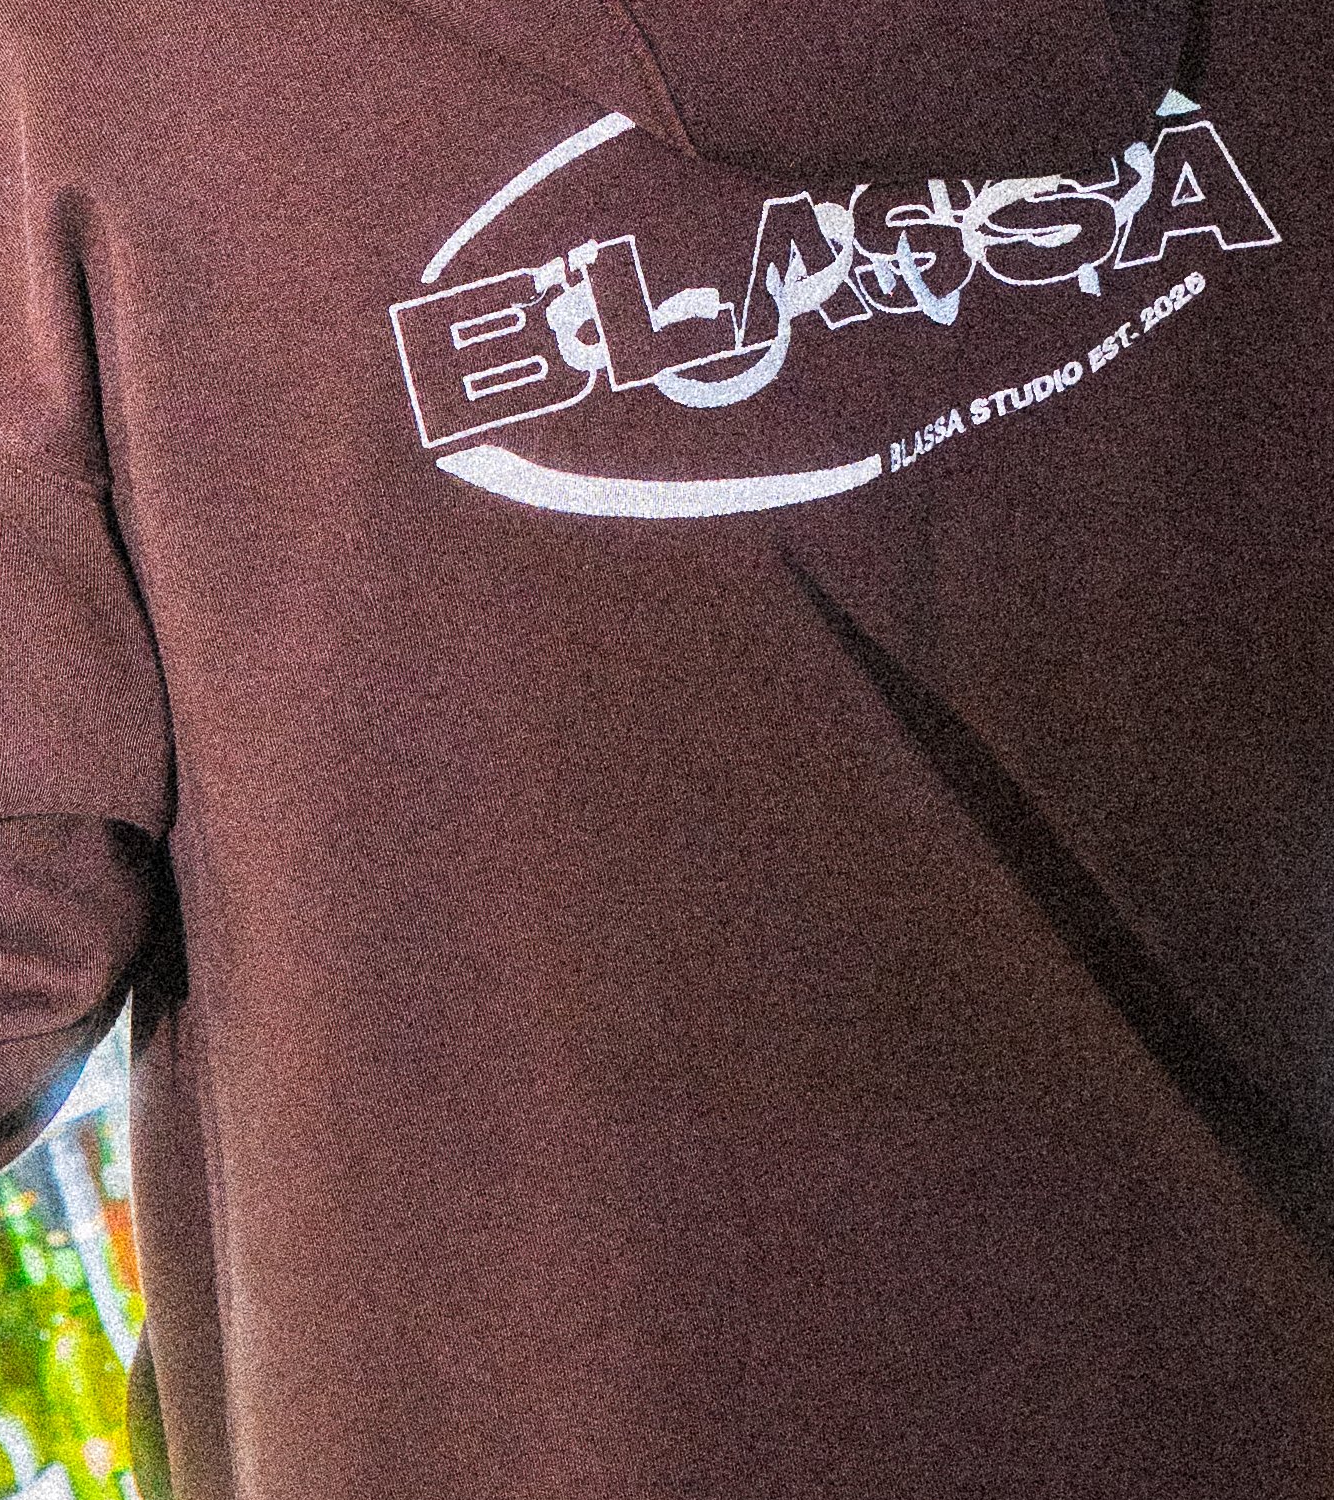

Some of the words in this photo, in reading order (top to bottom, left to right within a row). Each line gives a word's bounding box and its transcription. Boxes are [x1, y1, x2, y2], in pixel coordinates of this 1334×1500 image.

[890, 408, 967, 473] BLASSA
[970, 361, 1084, 425] STUDIO
[1087, 321, 1140, 373] EST.
